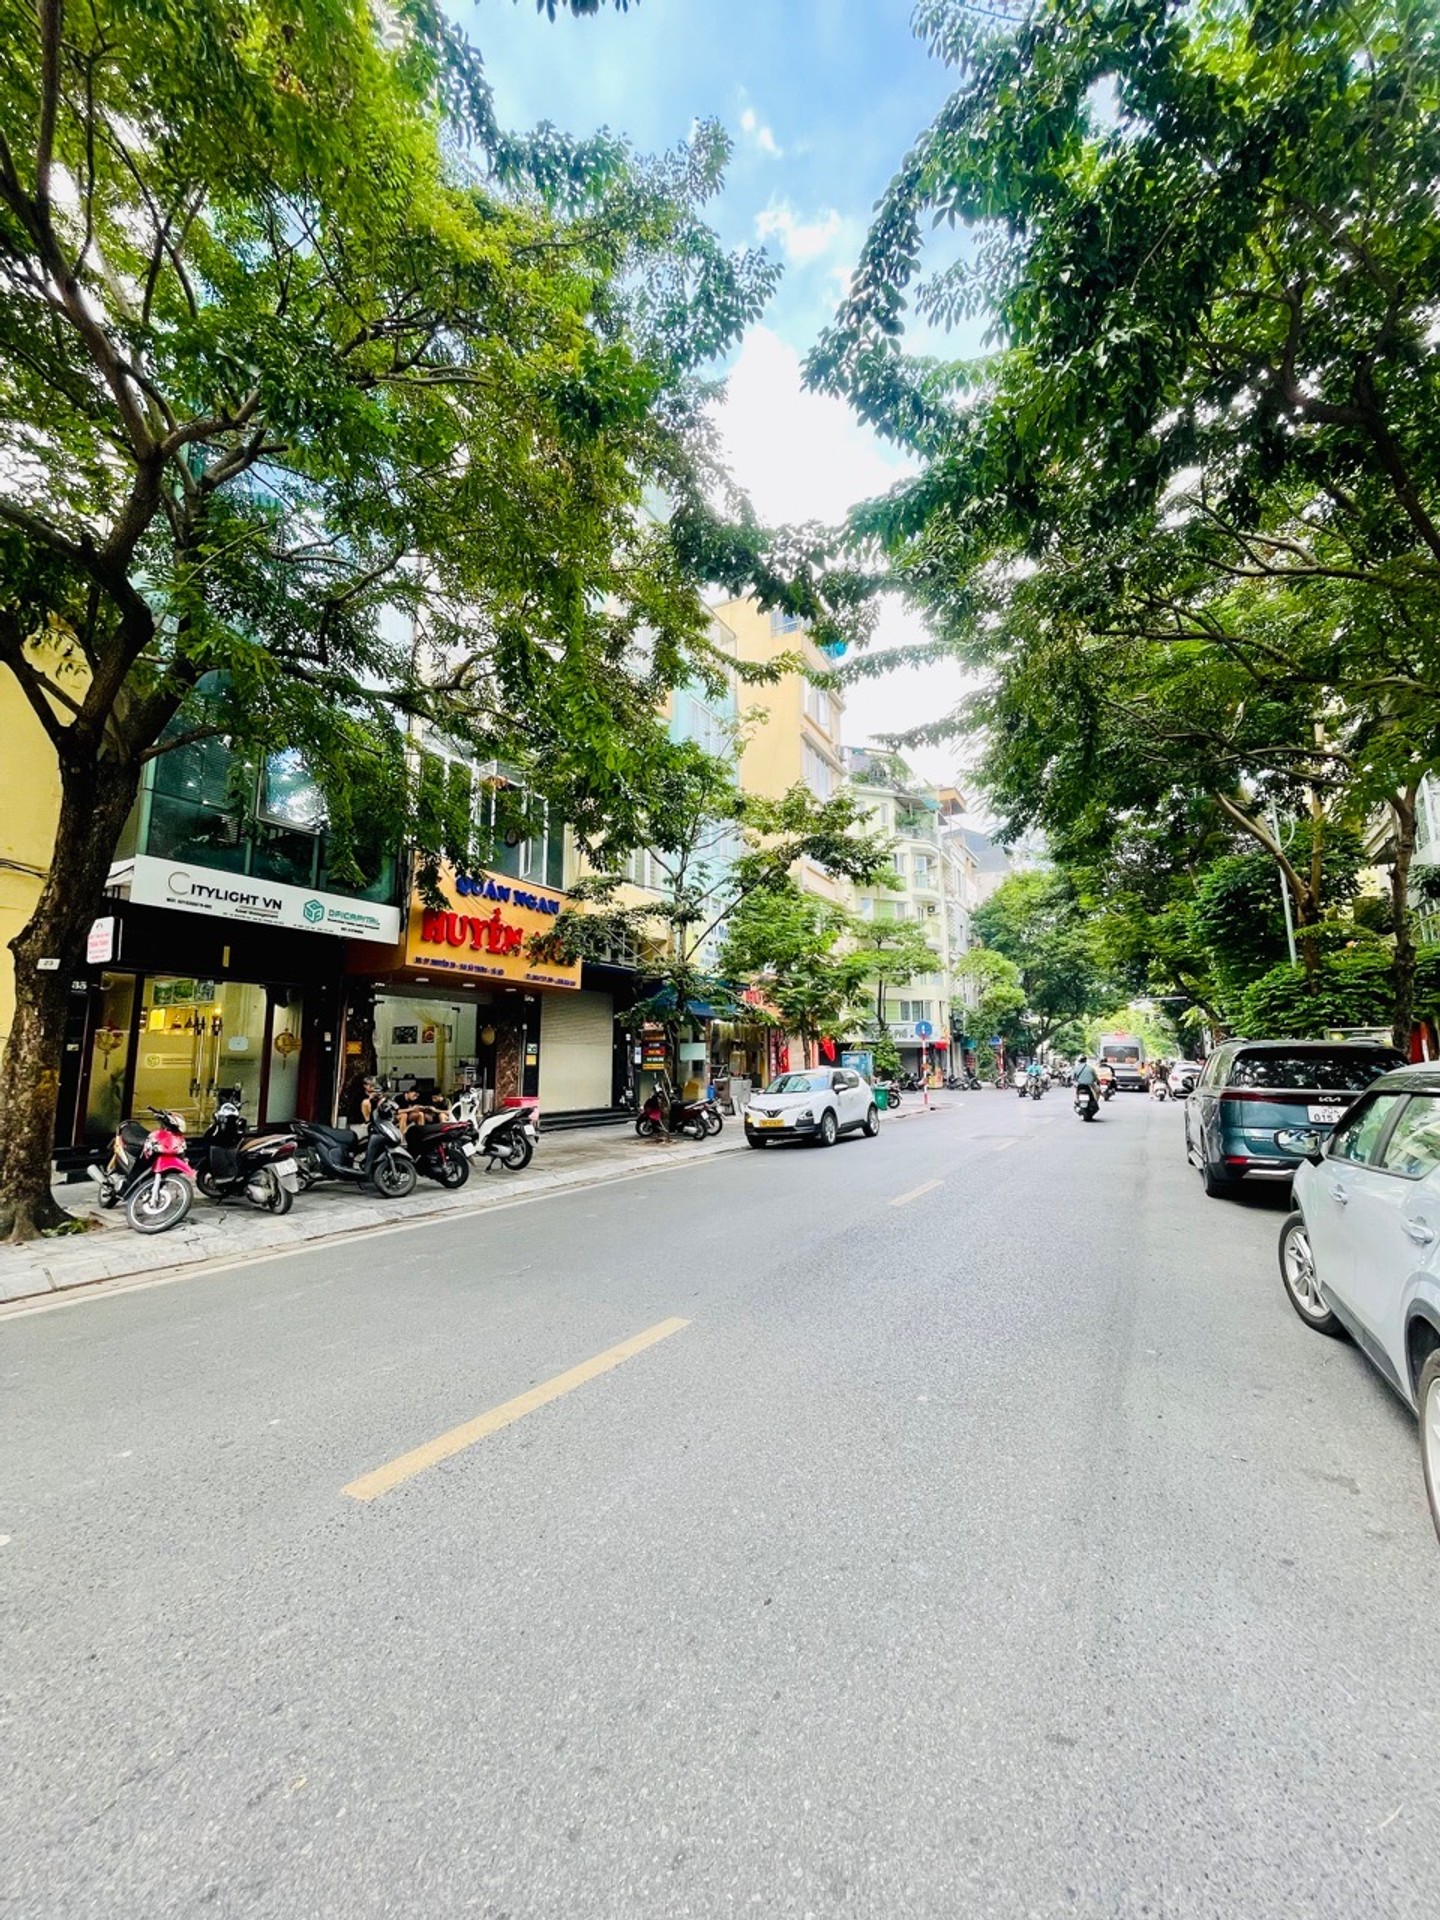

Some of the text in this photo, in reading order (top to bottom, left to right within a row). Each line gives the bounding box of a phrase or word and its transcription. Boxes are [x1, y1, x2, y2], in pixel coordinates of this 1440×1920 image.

[168, 872, 259, 906] CITYLIGHT
[262, 897, 282, 910] VN
[456, 874, 559, 915] QUÁN NGAN
